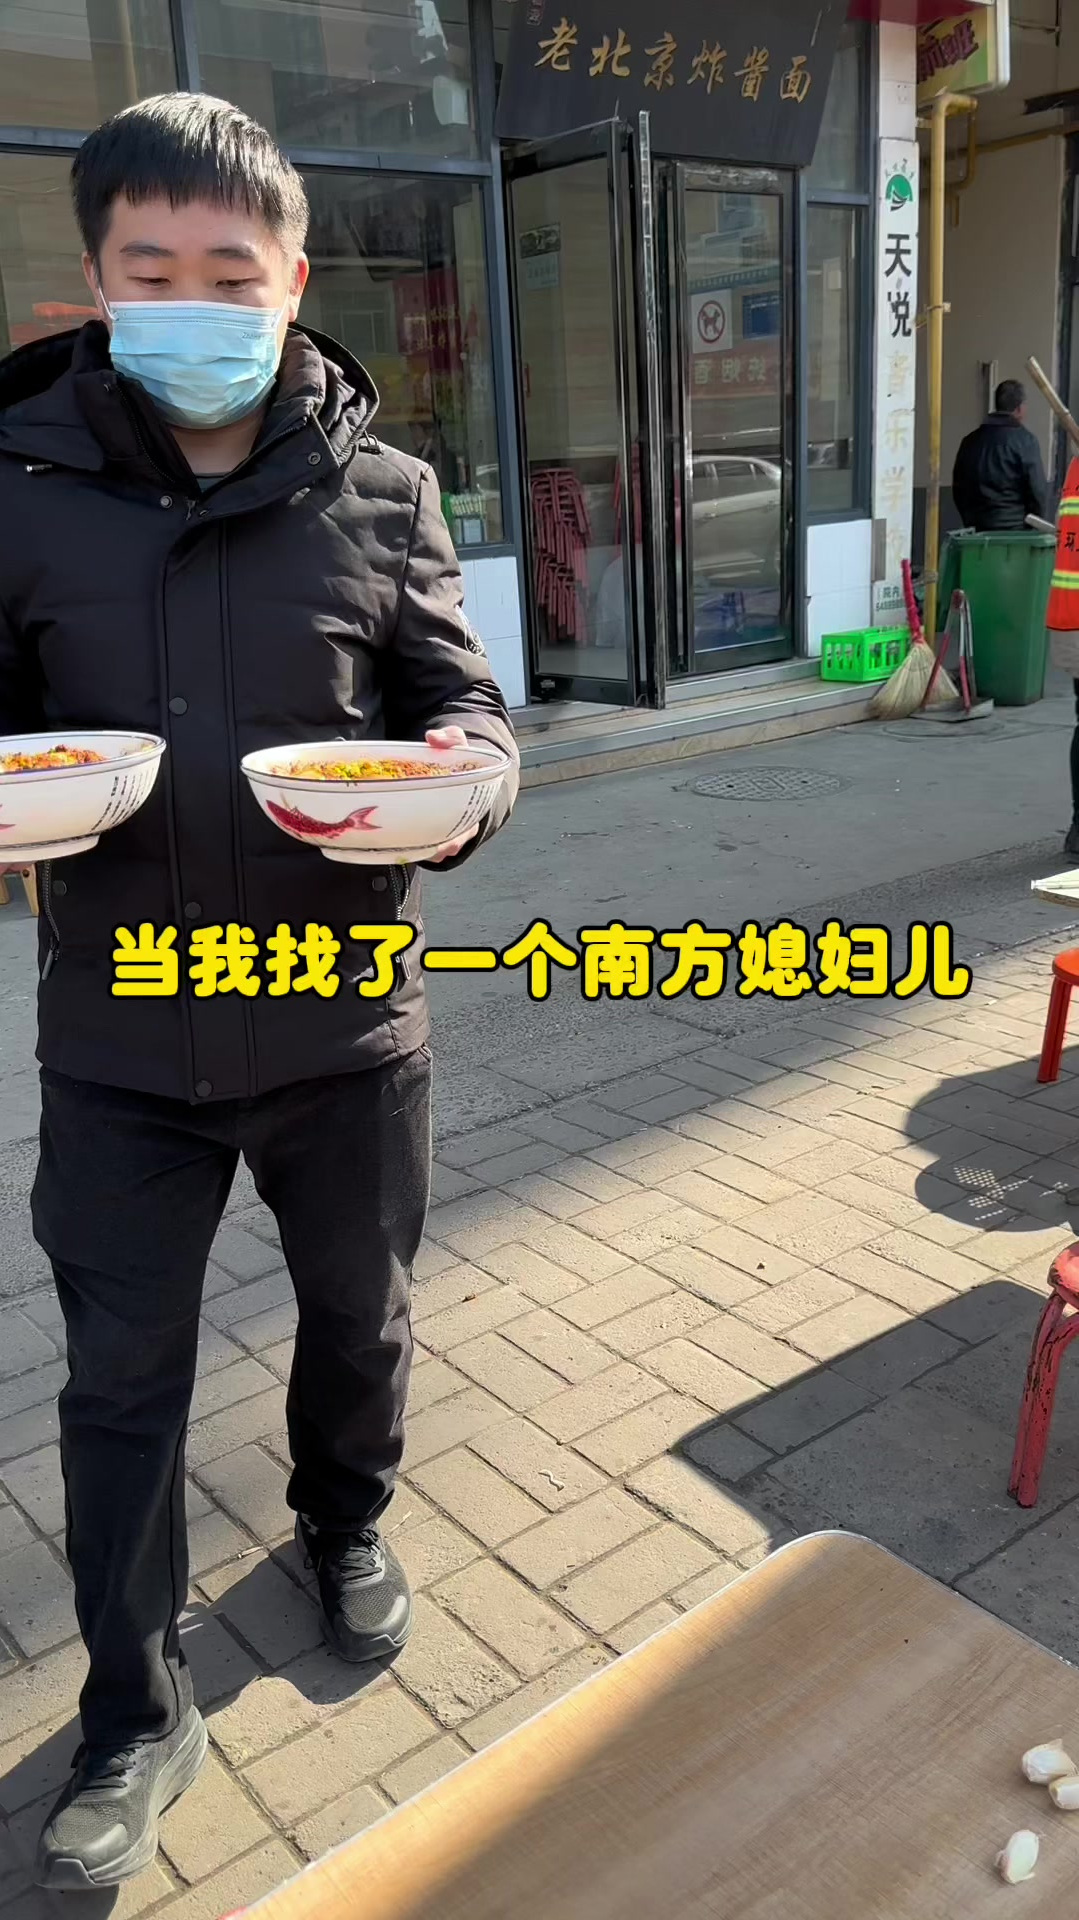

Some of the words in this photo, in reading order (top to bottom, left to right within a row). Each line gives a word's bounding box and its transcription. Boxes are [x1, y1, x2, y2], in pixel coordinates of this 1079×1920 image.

[534, 17, 812, 103] 老北京炸酱面
